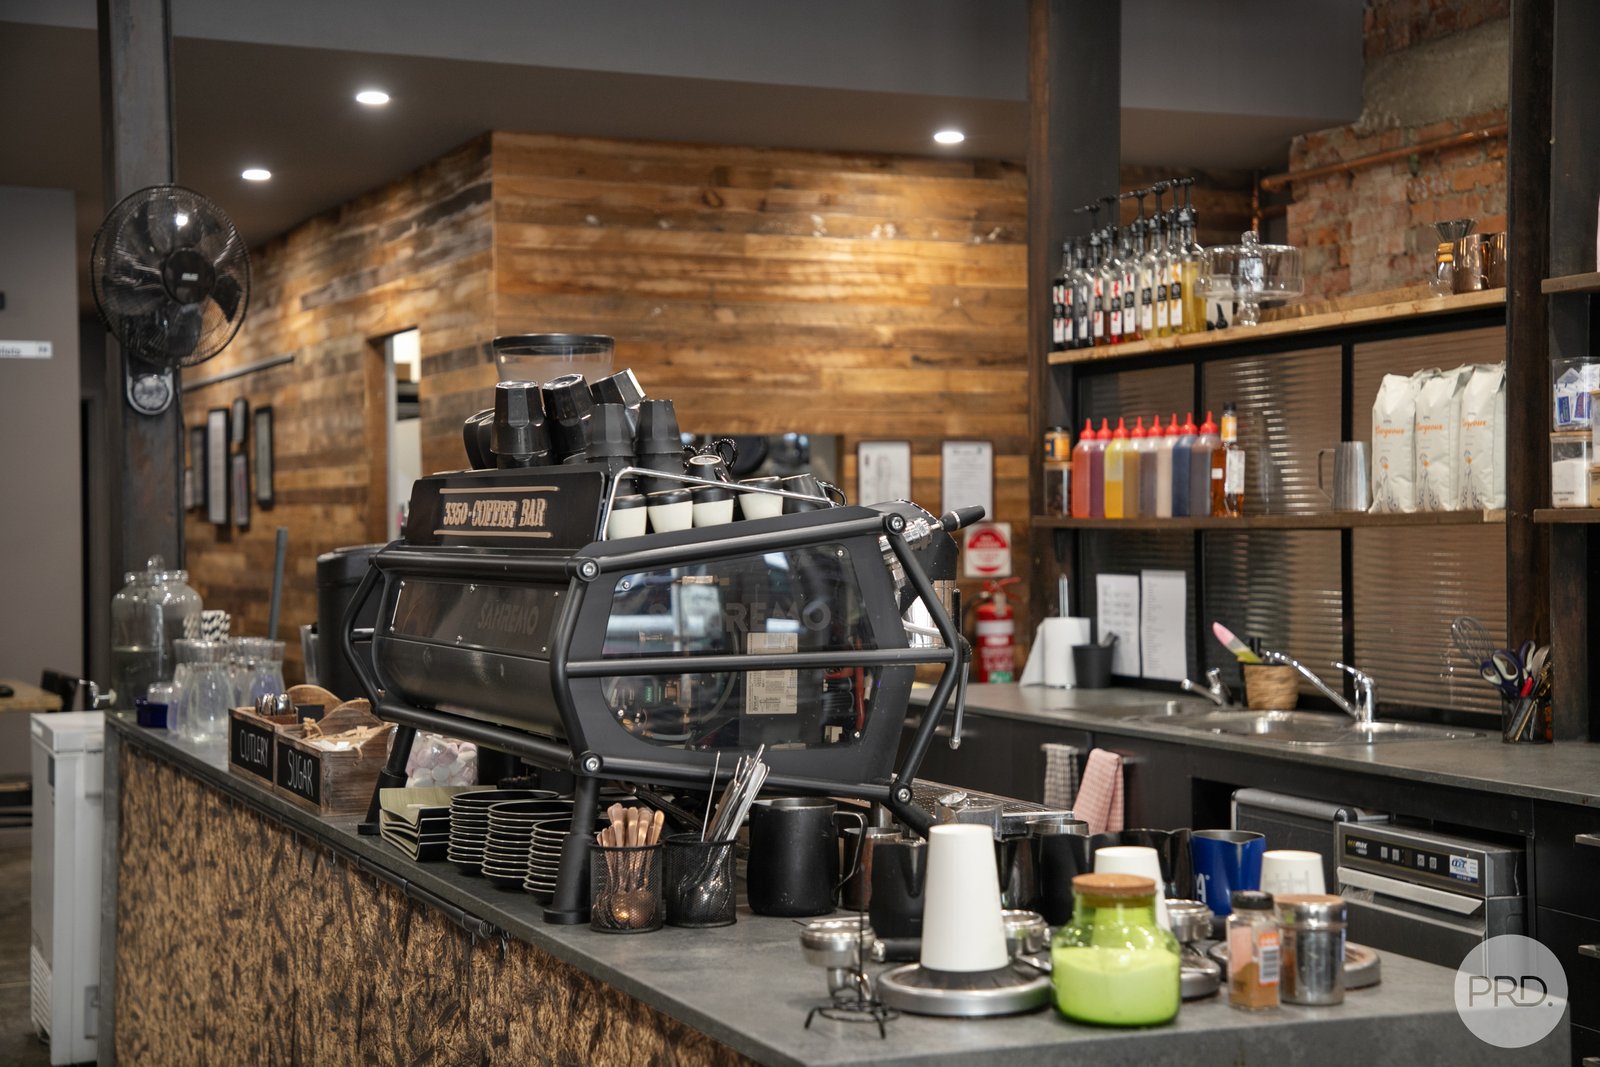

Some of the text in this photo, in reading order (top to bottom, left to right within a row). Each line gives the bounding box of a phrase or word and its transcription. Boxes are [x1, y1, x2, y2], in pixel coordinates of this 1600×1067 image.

[518, 498, 548, 527] BAR
[477, 600, 539, 636] SANREMO
[240, 729, 269, 768] CUTLERY
[287, 749, 314, 797] SUGAR
